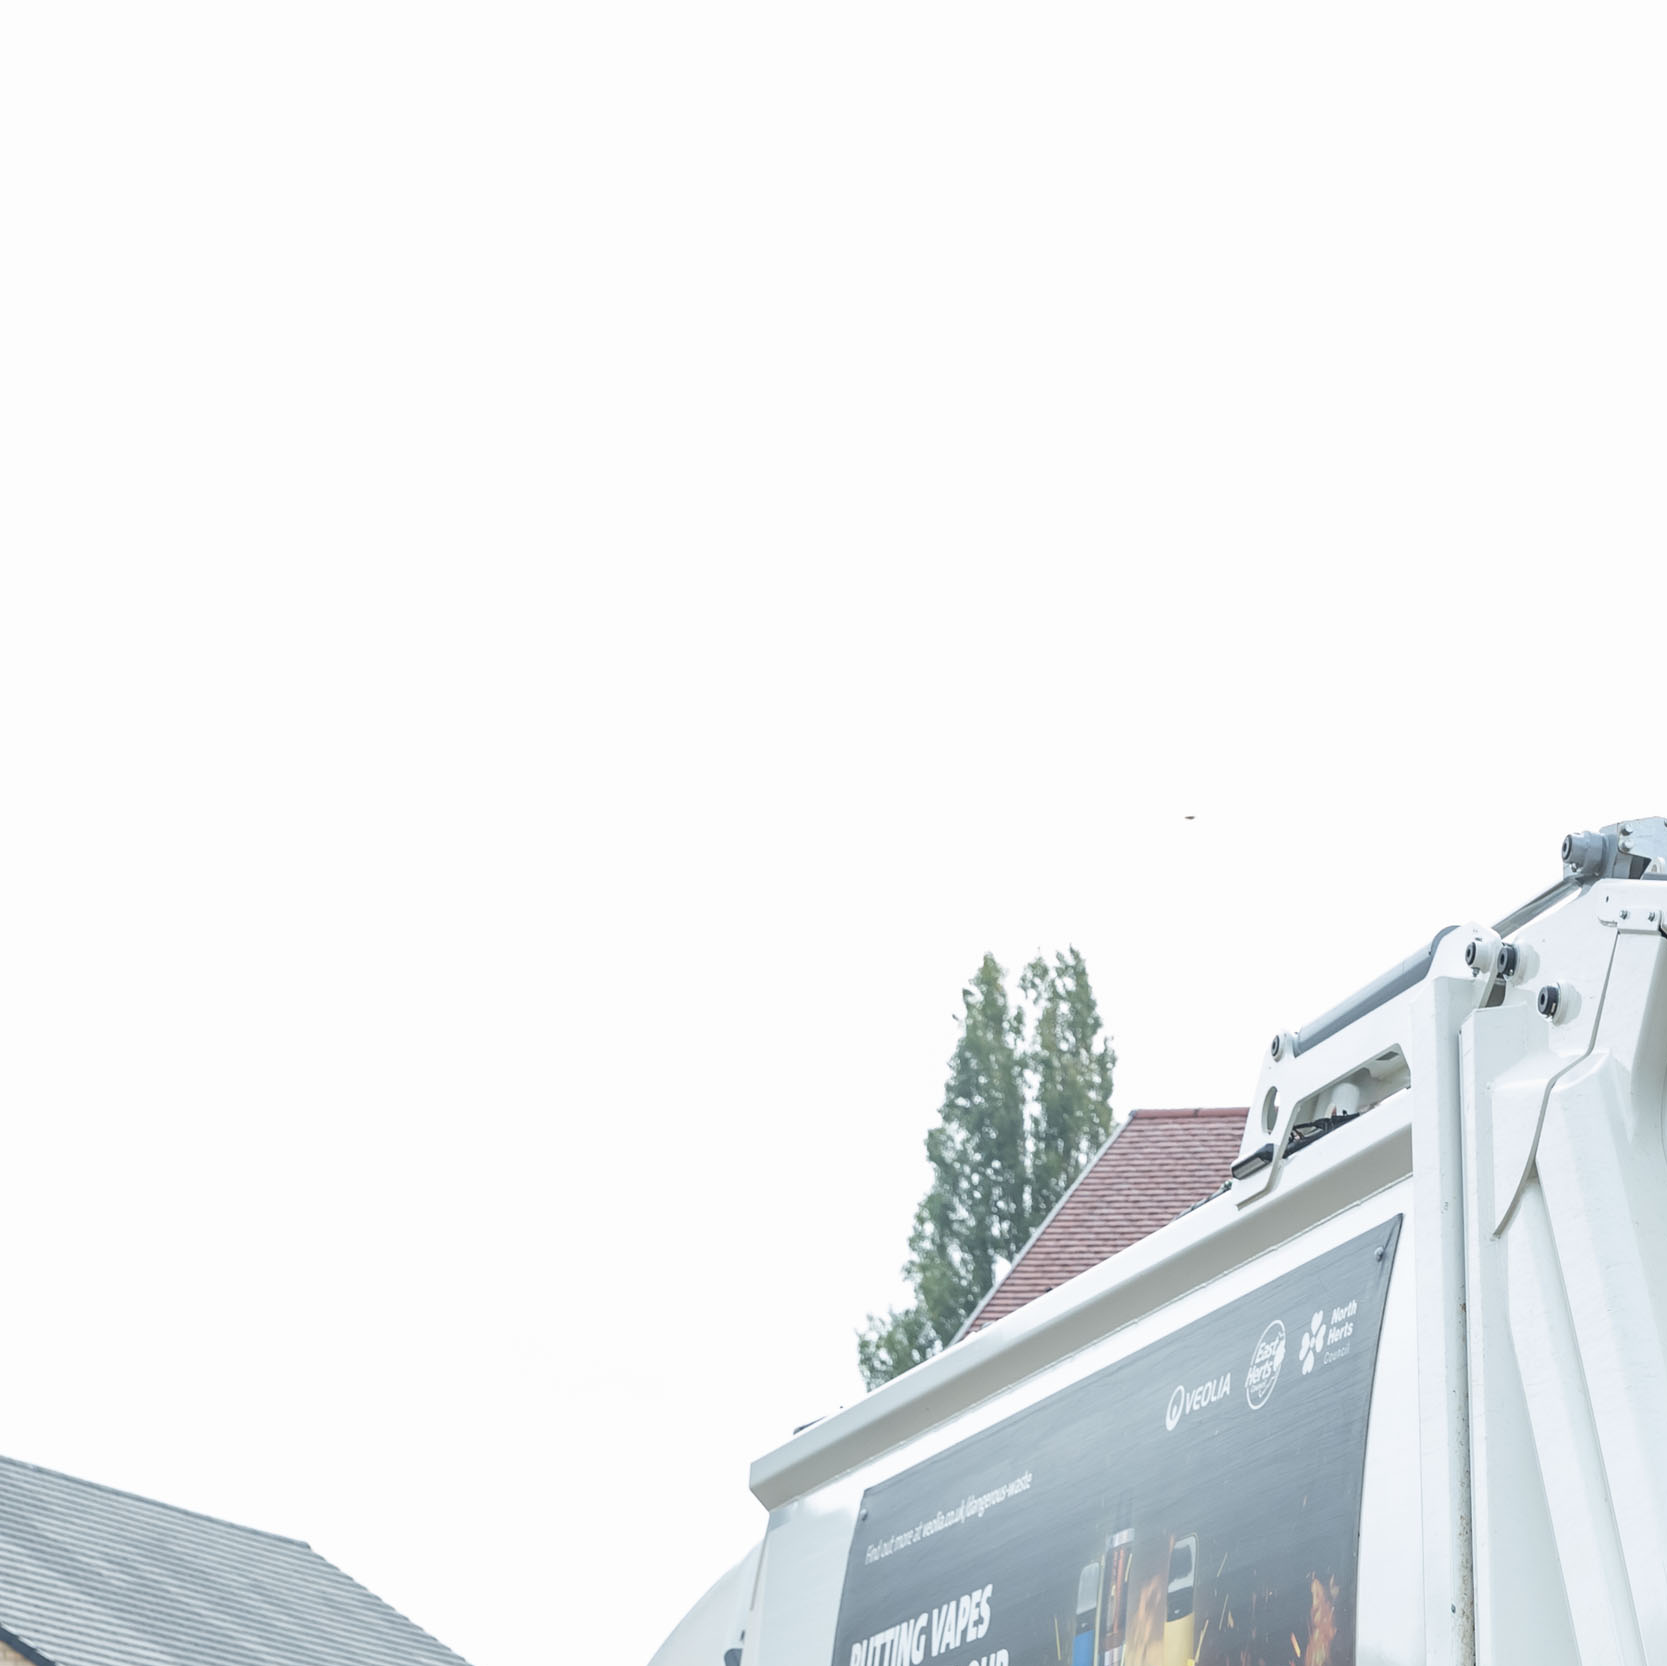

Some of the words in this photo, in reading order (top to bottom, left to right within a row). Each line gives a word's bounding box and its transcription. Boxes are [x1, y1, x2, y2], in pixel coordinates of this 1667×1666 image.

[1331, 1300, 1358, 1325] North
[1327, 1322, 1354, 1346] Herts
[1255, 1336, 1280, 1364] East
[1248, 1359, 1273, 1386] Herts
[1185, 1372, 1231, 1415] VEOLIA
[931, 1584, 993, 1657] VAPES
